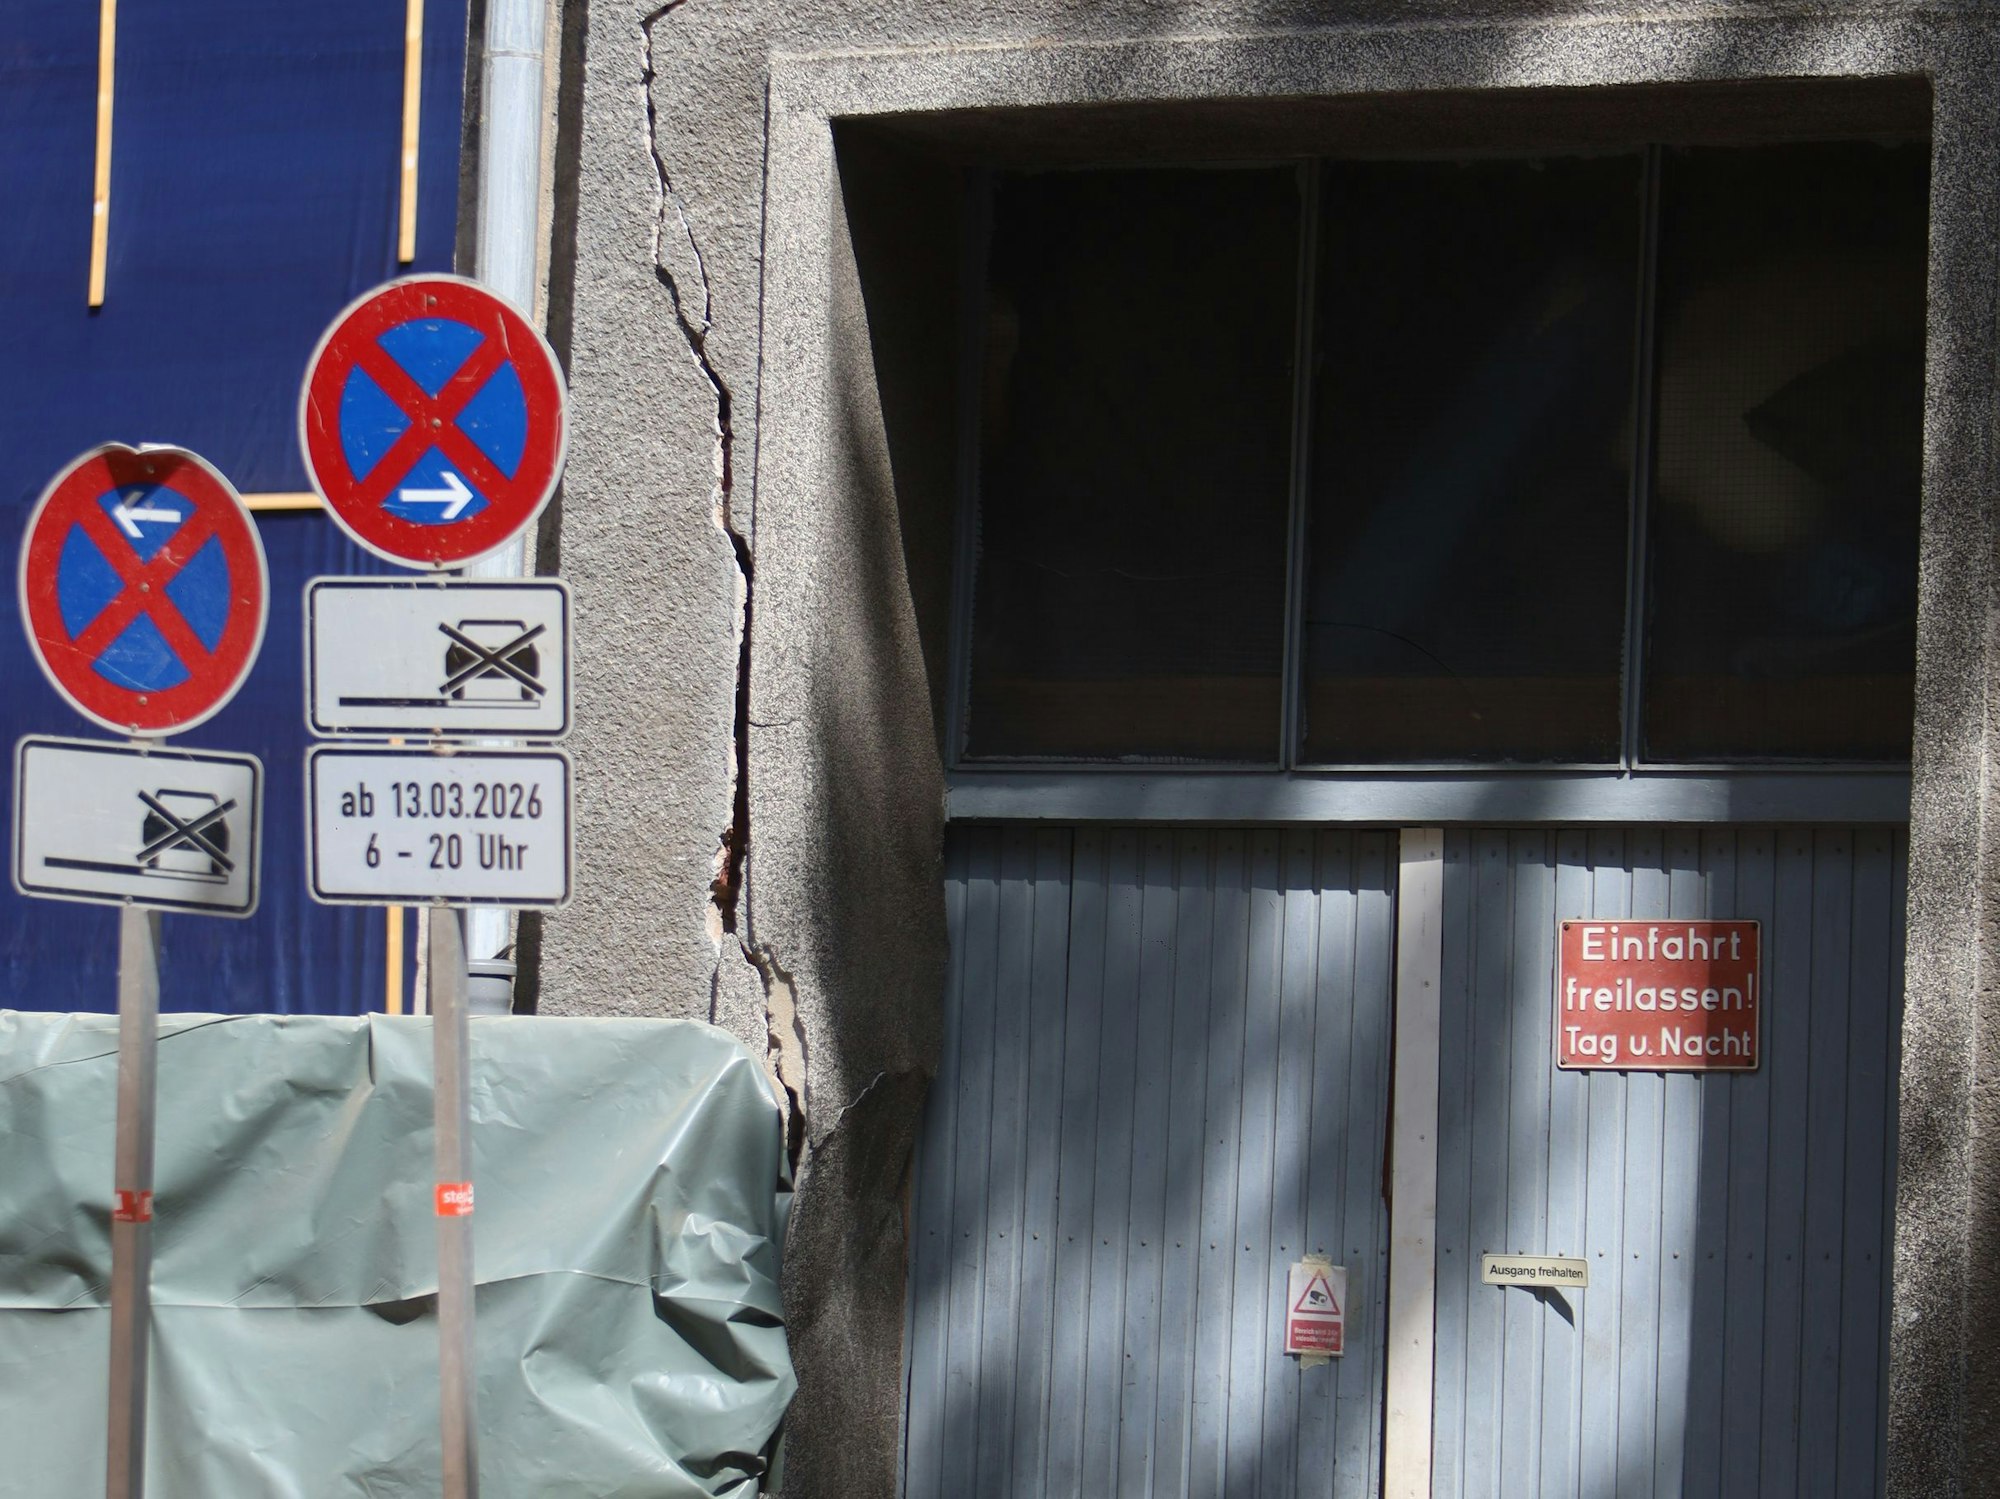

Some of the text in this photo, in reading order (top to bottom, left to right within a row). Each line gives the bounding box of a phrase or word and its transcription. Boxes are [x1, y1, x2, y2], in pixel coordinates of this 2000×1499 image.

[341, 782, 543, 819] ab 13.03.2026
[365, 833, 381, 868] 6
[429, 833, 462, 869] 20
[478, 833, 529, 870] Uhr
[1582, 926, 1740, 961] Einfahrt
[1566, 973, 1753, 1011] freilassen!
[1565, 1026, 1751, 1064] Tag u. Nacht
[1490, 1265, 1583, 1279] Ausgang freihalten
